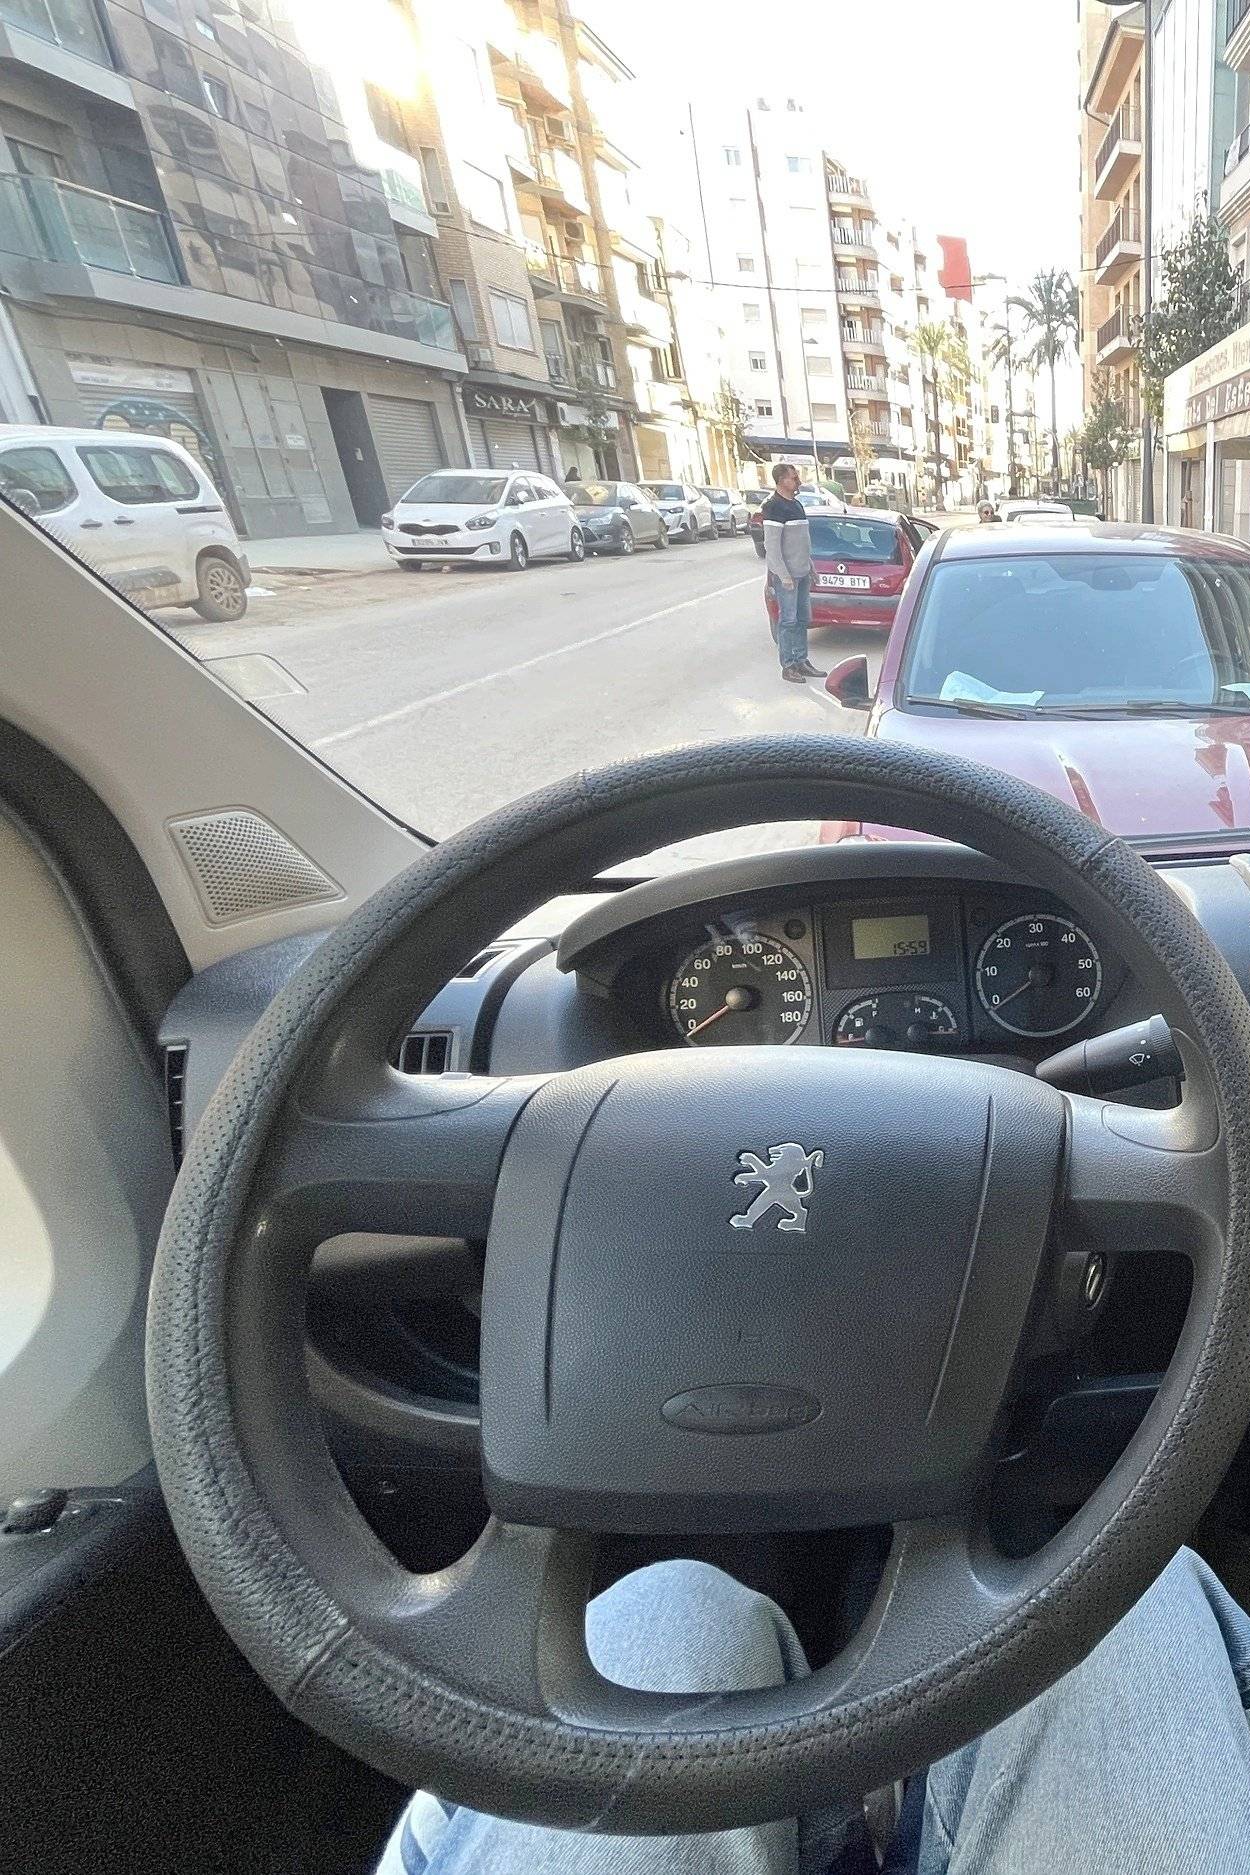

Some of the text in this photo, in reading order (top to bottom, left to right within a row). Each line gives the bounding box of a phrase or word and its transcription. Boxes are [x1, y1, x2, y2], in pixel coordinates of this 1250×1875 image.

[474, 393, 530, 413] SARA
[821, 575, 867, 587] 9479 BTY
[1029, 923, 1043, 933] 30
[996, 938, 1011, 948] 20
[1061, 933, 1076, 943] 40
[716, 945, 733, 956] 80
[742, 943, 763, 955] 100
[694, 959, 711, 970] 60
[762, 954, 783, 965] 120
[1078, 958, 1093, 969] 50
[776, 970, 797, 981] 140
[985, 966, 998, 977] 10
[681, 977, 699, 988] 40
[782, 990, 803, 1003] 160
[1075, 987, 1091, 998] 60
[680, 999, 697, 1010] 20
[992, 994, 1000, 1005] 0
[780, 1011, 801, 1023] 180
[688, 1019, 697, 1030] 0
